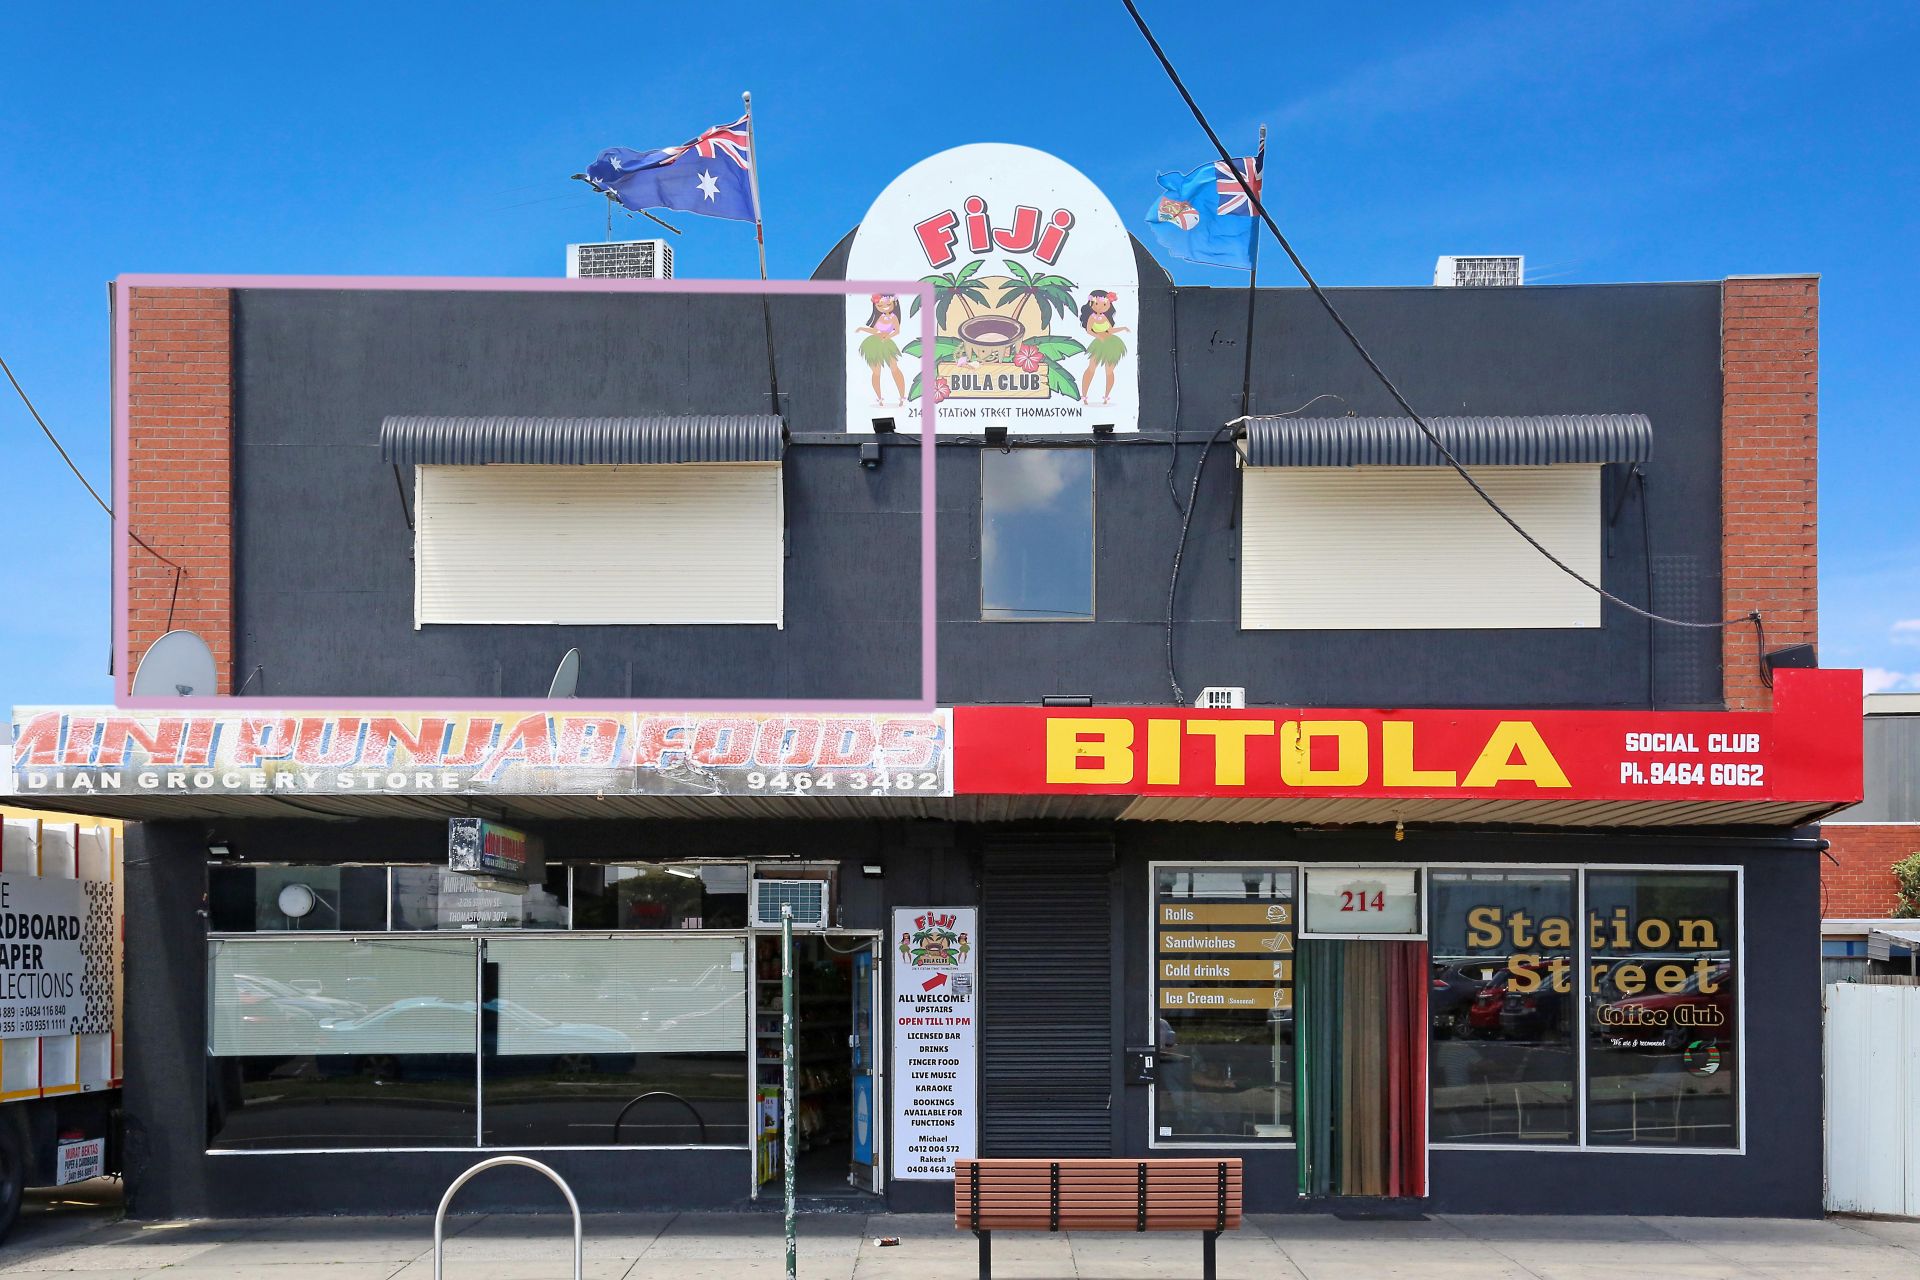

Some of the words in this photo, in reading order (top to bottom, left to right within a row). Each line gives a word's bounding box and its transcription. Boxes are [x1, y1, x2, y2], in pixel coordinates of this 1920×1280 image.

[951, 374, 994, 391] BULA
[998, 374, 1041, 391] CLUB
[981, 407, 1012, 418] STREET
[1016, 407, 1082, 418] THOMASTOWN
[234, 712, 626, 782] PUNJAB
[636, 714, 945, 769] FOODS
[1625, 732, 1700, 752] SOCIAL
[1708, 733, 1760, 753] CLUB
[1045, 717, 1572, 788] BITOLA
[137, 771, 318, 790] GROCERY
[336, 771, 460, 790] STORE
[747, 771, 836, 790] 9464
[849, 772, 938, 791] 3482
[1710, 763, 1764, 786] 6062
[1340, 891, 1385, 912] 214
[449, 912, 492, 922] THOMASTOWN
[492, 912, 508, 922] 3074
[1165, 908, 1194, 921] Rolls
[1466, 906, 1719, 949] Station
[1165, 936, 1236, 949] Sandwiches
[1165, 963, 1190, 977] Cold
[1194, 963, 1231, 977] drinks
[1507, 952, 1719, 994] Street
[898, 994, 916, 1003] ALL
[917, 994, 965, 1003] WELCOME
[1165, 991, 1183, 1004] Ice
[1187, 991, 1225, 1004] Cream
[25, 1006, 41, 1017] 0434
[42, 1005, 54, 1016] 116
[54, 1004, 66, 1015] 840
[1597, 1004, 1669, 1026] Coffee
[1673, 1004, 1725, 1026] Club
[25, 1021, 34, 1031] 03
[34, 1020, 50, 1031] 9351
[51, 1019, 66, 1030] 1111
[898, 1017, 924, 1026] OPEN
[925, 1017, 943, 1026] TILL
[945, 1017, 954, 1026] 11
[955, 1017, 971, 1026] PM
[907, 1032, 944, 1040] LICENSED
[945, 1032, 961, 1040] BAR
[908, 1145, 927, 1153] 0412
[928, 1145, 945, 1153] 004
[946, 1145, 960, 1153] 572
[920, 1155, 947, 1163] Rakesh
